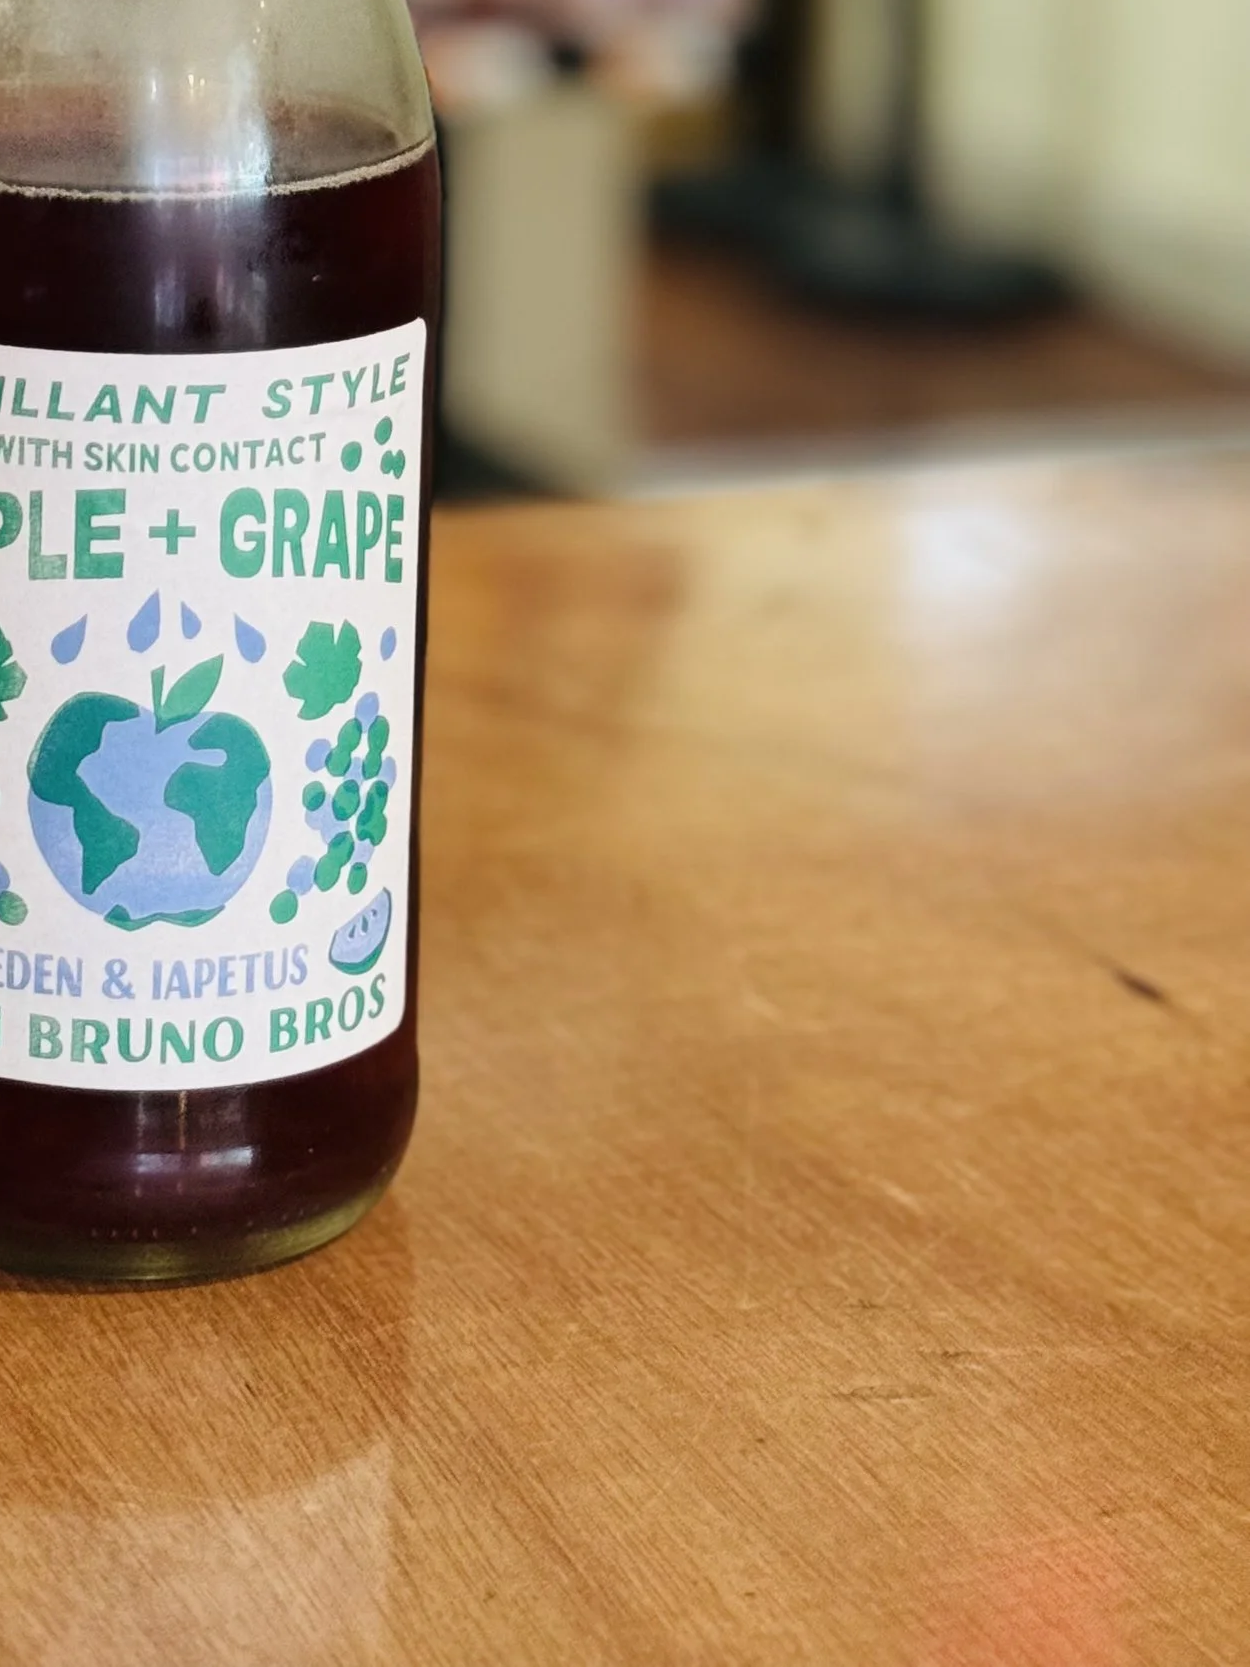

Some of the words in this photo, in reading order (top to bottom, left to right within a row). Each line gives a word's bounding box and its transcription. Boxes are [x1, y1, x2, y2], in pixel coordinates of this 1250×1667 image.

[261, 352, 411, 419] STYLE
[84, 442, 160, 473] SKIN
[170, 432, 327, 473] CONTACT
[219, 487, 405, 584] GRAPE
[101, 957, 136, 999] &
[152, 943, 309, 1000] IAPETUS
[28, 1013, 244, 1064] BRUNO
[269, 973, 386, 1054] BROS
